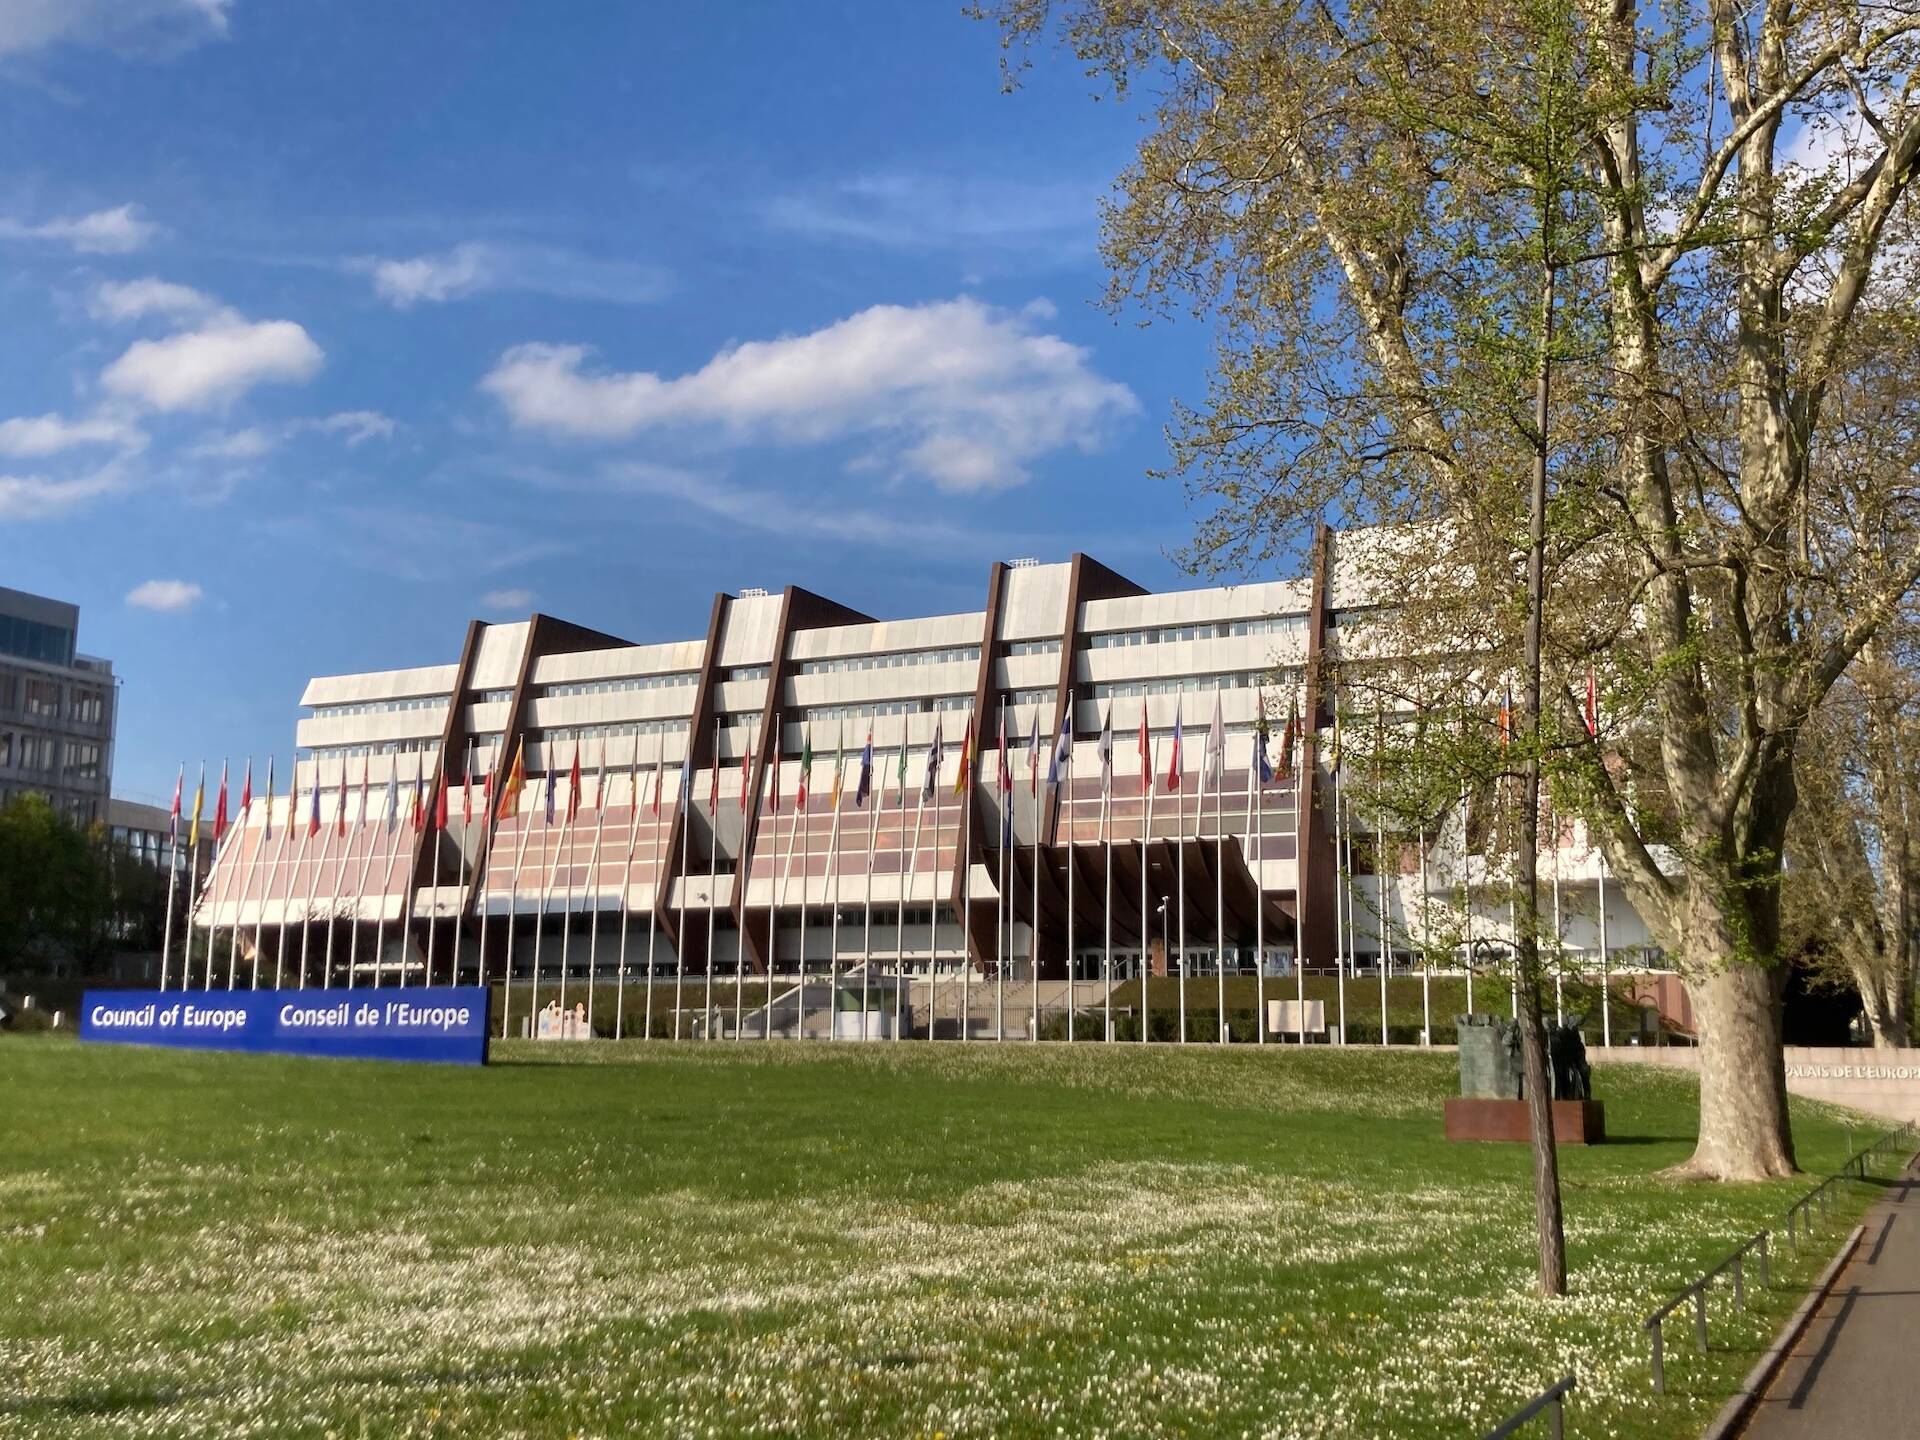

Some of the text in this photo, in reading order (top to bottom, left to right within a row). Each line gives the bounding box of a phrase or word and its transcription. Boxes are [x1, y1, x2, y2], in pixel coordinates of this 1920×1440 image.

[91, 1005, 247, 1032] Council of Europe
[279, 1003, 470, 1031] Conseil de l'Europe
[1832, 1066, 1853, 1078] DE
